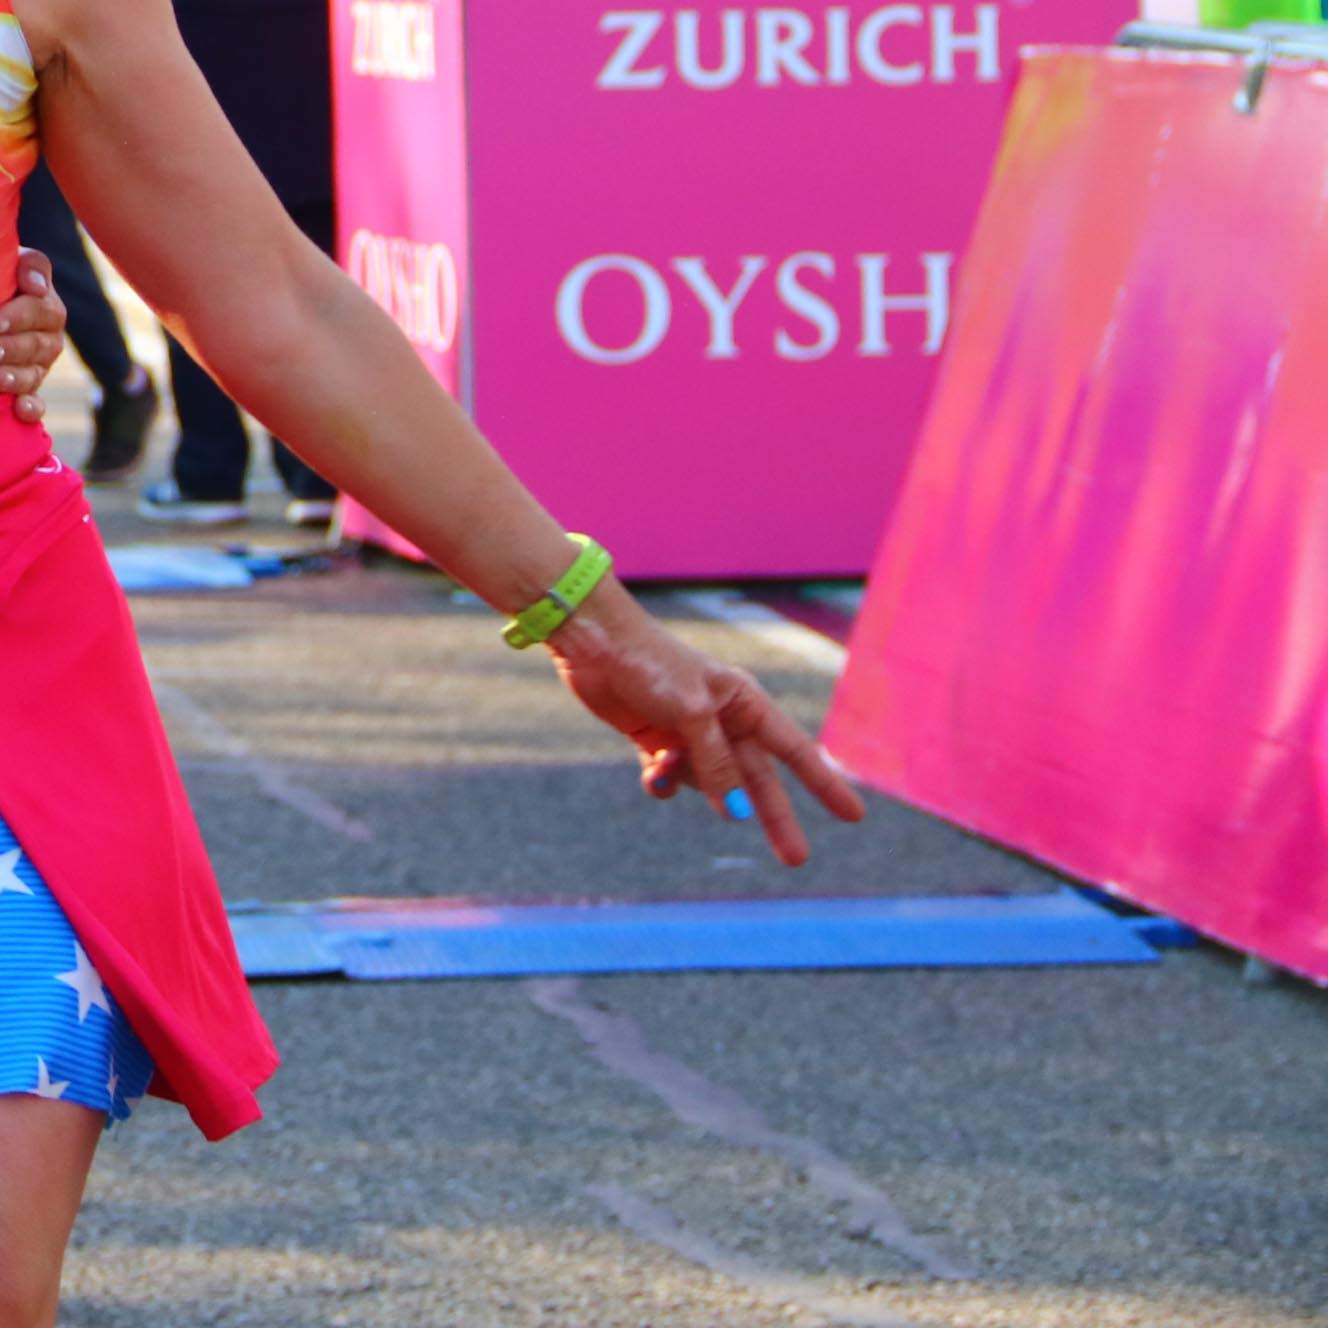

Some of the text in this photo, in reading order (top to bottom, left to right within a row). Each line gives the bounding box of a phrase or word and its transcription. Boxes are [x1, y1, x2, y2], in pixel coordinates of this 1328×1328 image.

[351, 0, 436, 80] ZURICH
[595, 3, 1002, 91] ZURICH
[556, 251, 955, 366] OYSH
